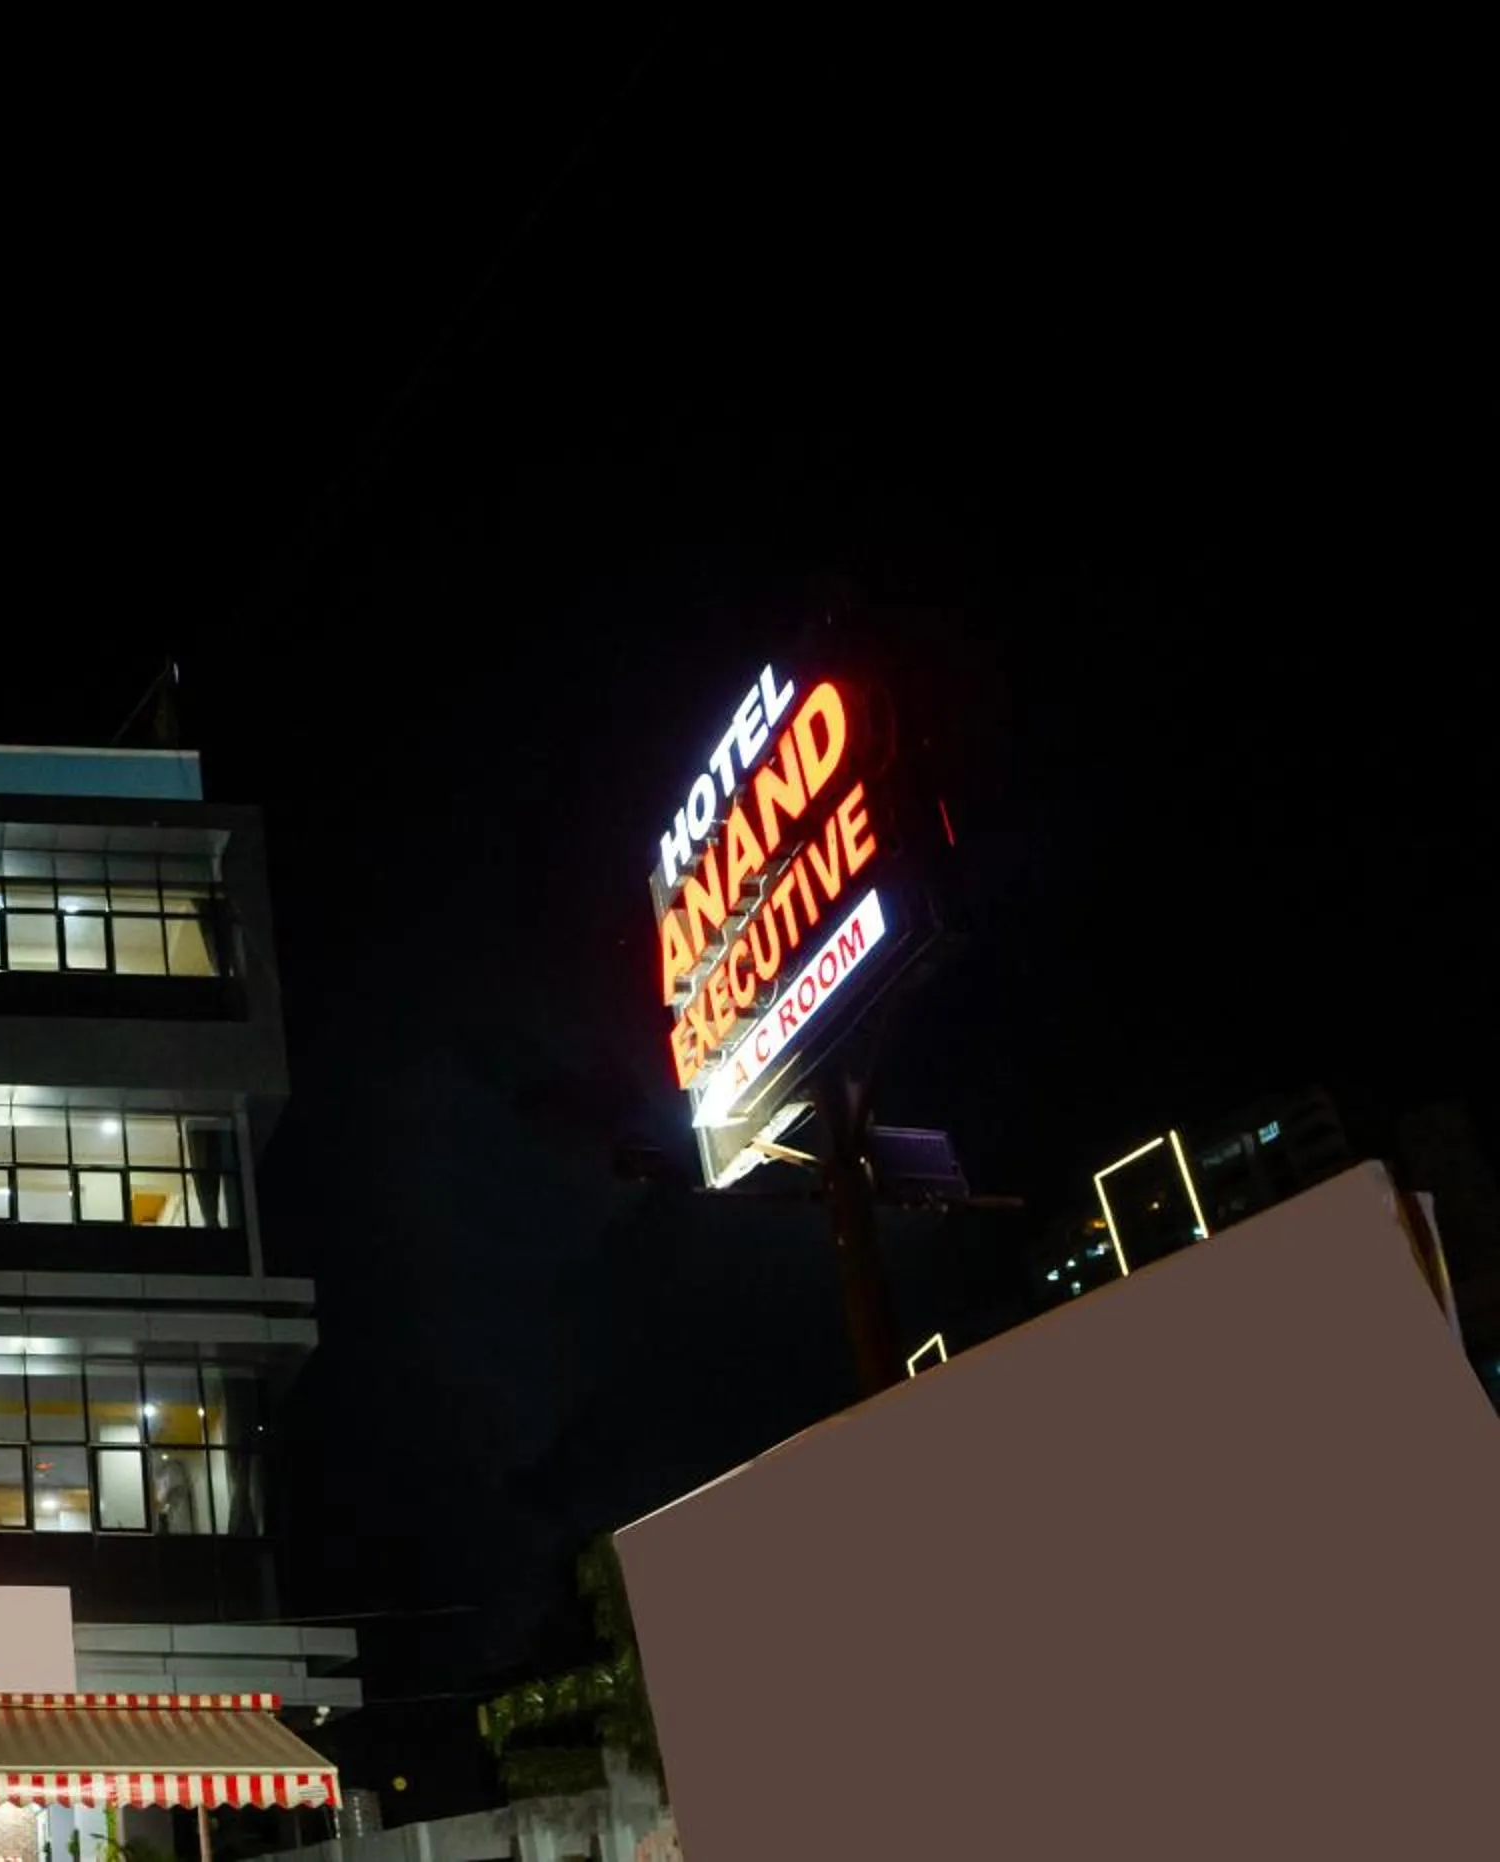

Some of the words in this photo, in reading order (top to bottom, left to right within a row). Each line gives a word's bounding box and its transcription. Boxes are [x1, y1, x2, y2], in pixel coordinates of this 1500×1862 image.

[658, 663, 794, 888] HOTEL
[660, 681, 847, 1007] ANAND
[668, 782, 878, 1090] EXECUTIVE
[754, 1028, 772, 1063] C
[777, 917, 866, 1039] ROOM
